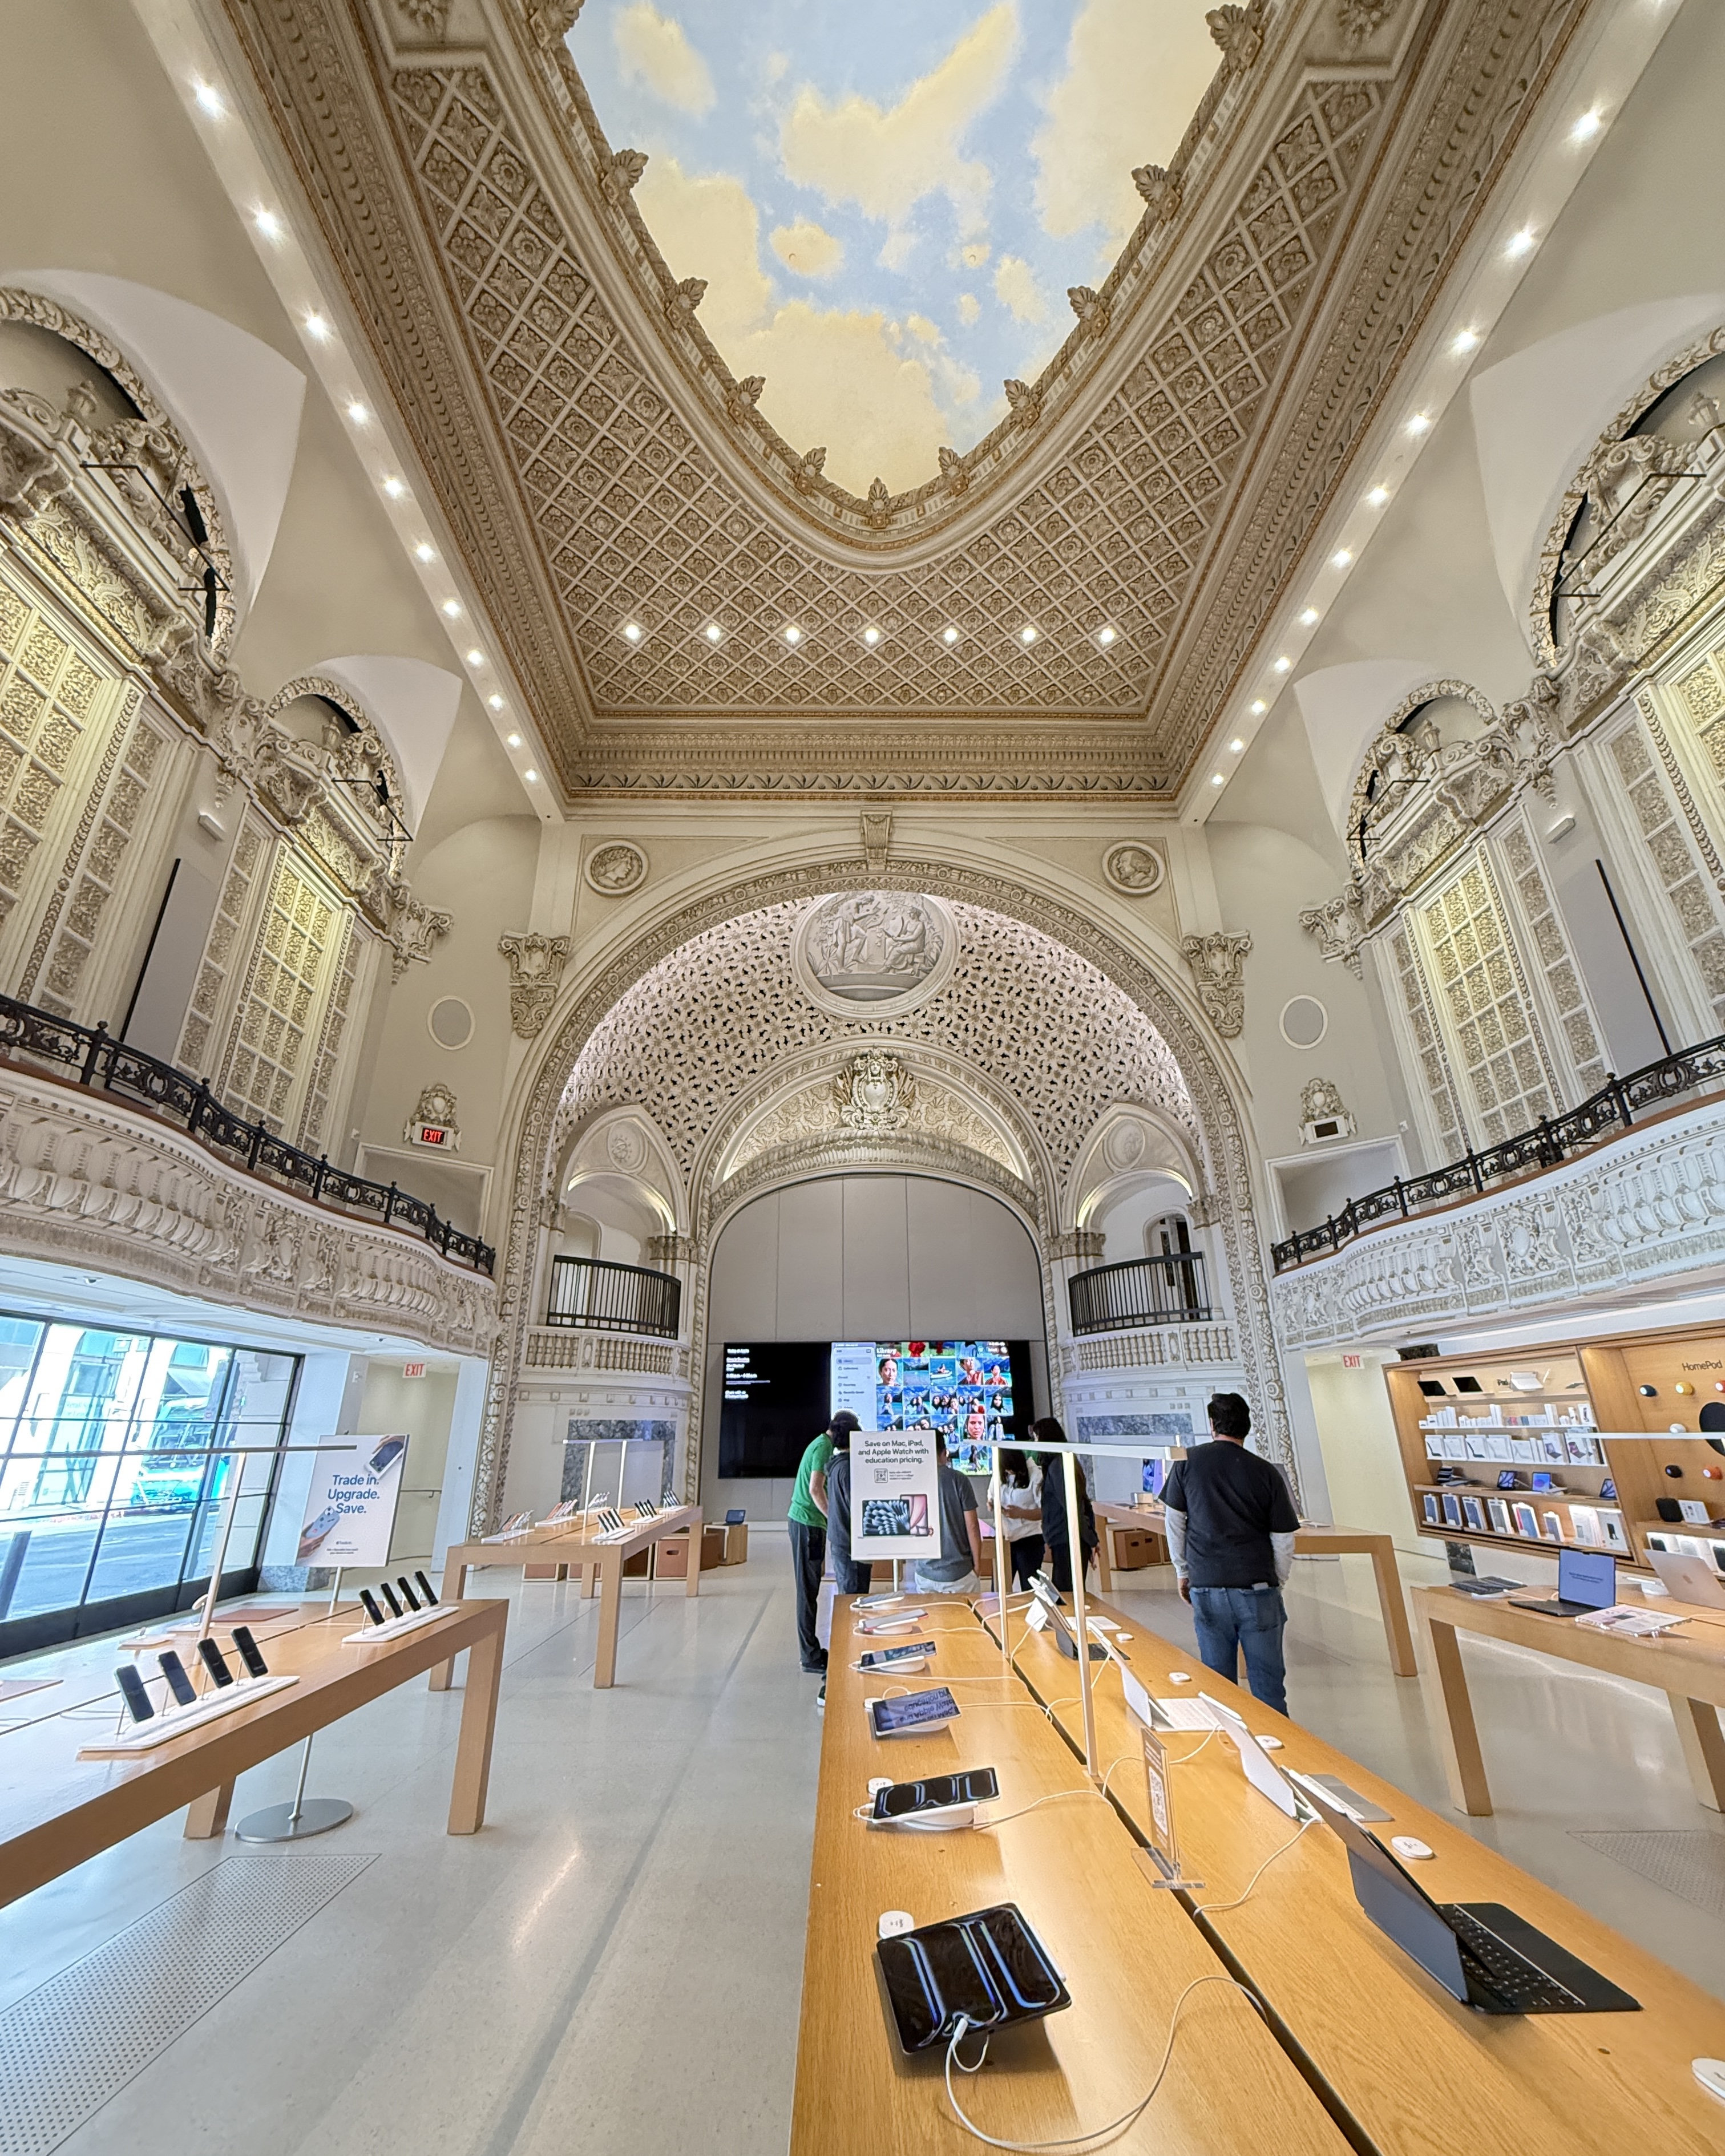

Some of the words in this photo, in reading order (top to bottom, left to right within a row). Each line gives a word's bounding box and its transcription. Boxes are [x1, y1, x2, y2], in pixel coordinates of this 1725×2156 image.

[423, 1129, 443, 1143] EXIT
[1343, 1356, 1360, 1368] EXIT
[1682, 1359, 1723, 1372] HomePod
[405, 1364, 425, 1376] EXIT
[333, 1474, 364, 1486] Trade
[366, 1474, 379, 1485] in.
[328, 1488, 380, 1502] Upgrade.
[336, 1503, 366, 1514] Save.
